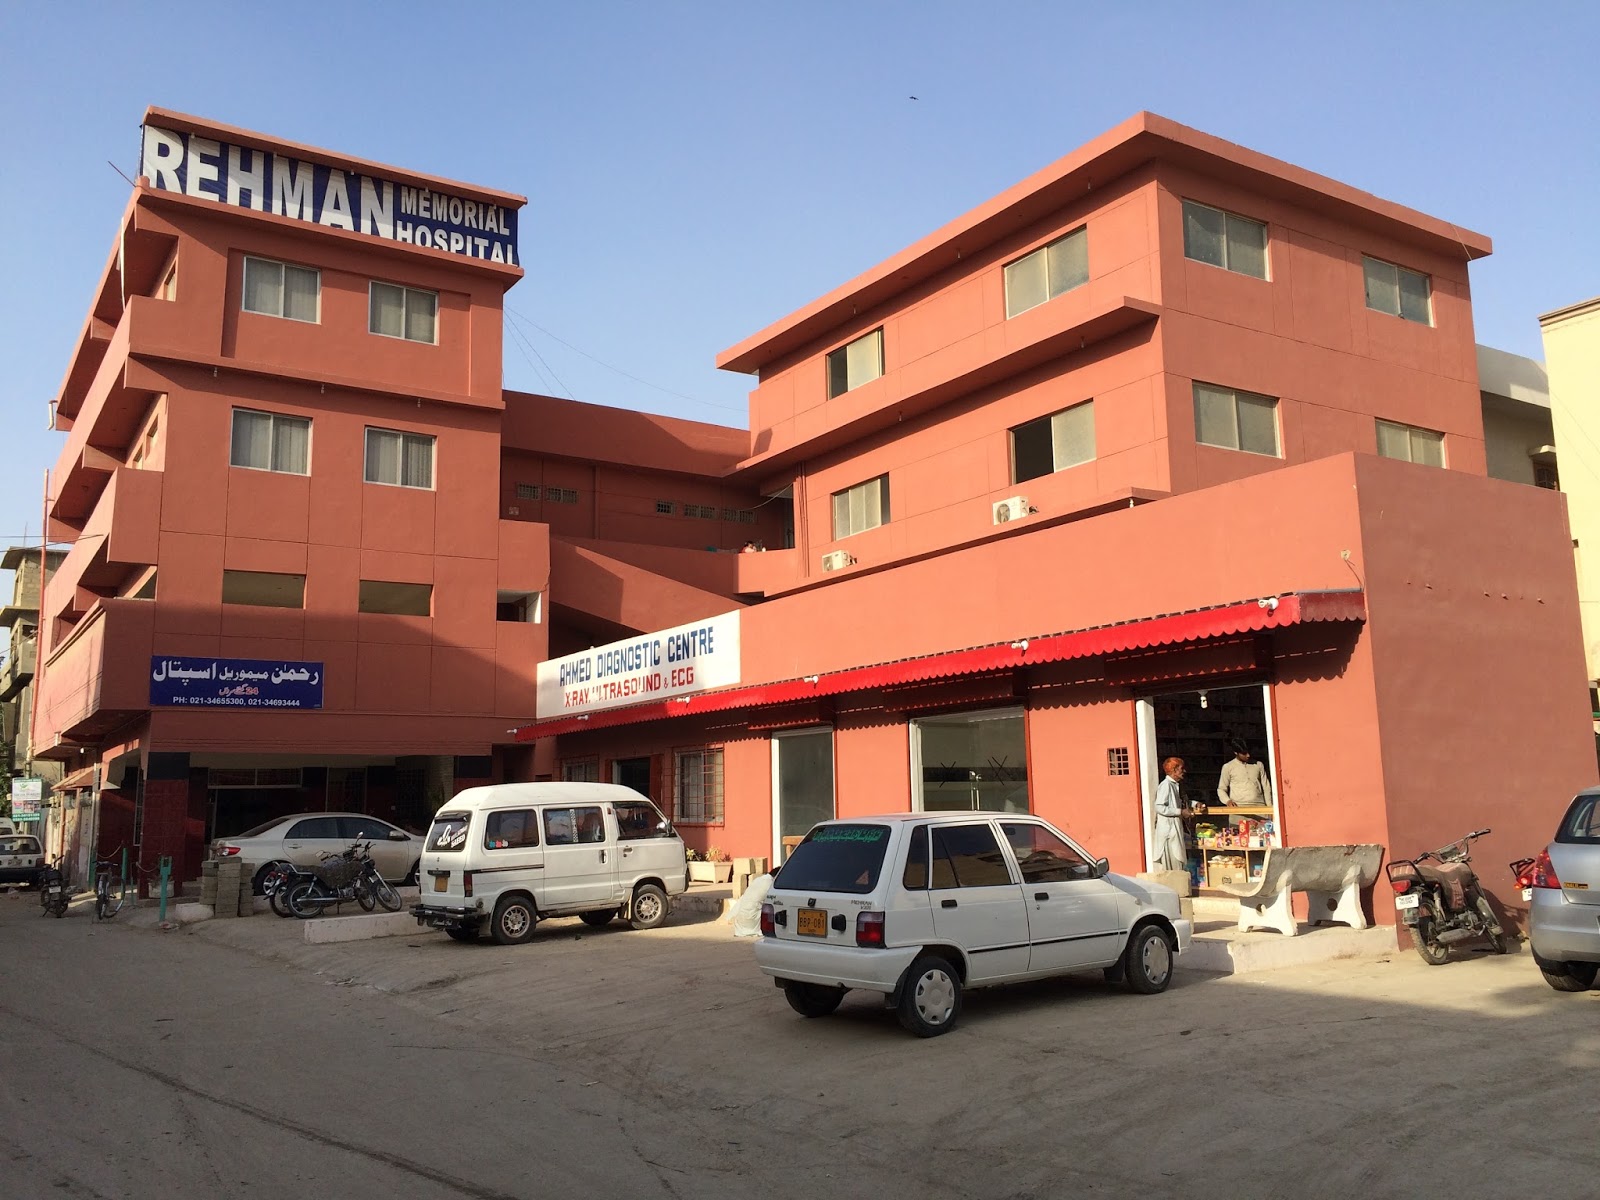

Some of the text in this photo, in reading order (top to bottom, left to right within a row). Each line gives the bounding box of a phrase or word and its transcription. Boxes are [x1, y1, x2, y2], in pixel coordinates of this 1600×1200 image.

[144, 125, 393, 240] REHMAN
[401, 186, 510, 236] MEMORIAL
[396, 220, 518, 267] HOSPITAL
[152, 660, 217, 686] اسپتال
[218, 667, 269, 682] میموریل
[560, 626, 714, 687] AHMED DIAGNOSTIC CENTRE
[664, 677, 669, 689] &
[672, 666, 694, 688] ECG
[173, 696, 188, 704] PH:
[248, 697, 300, 707] 021-34693444
